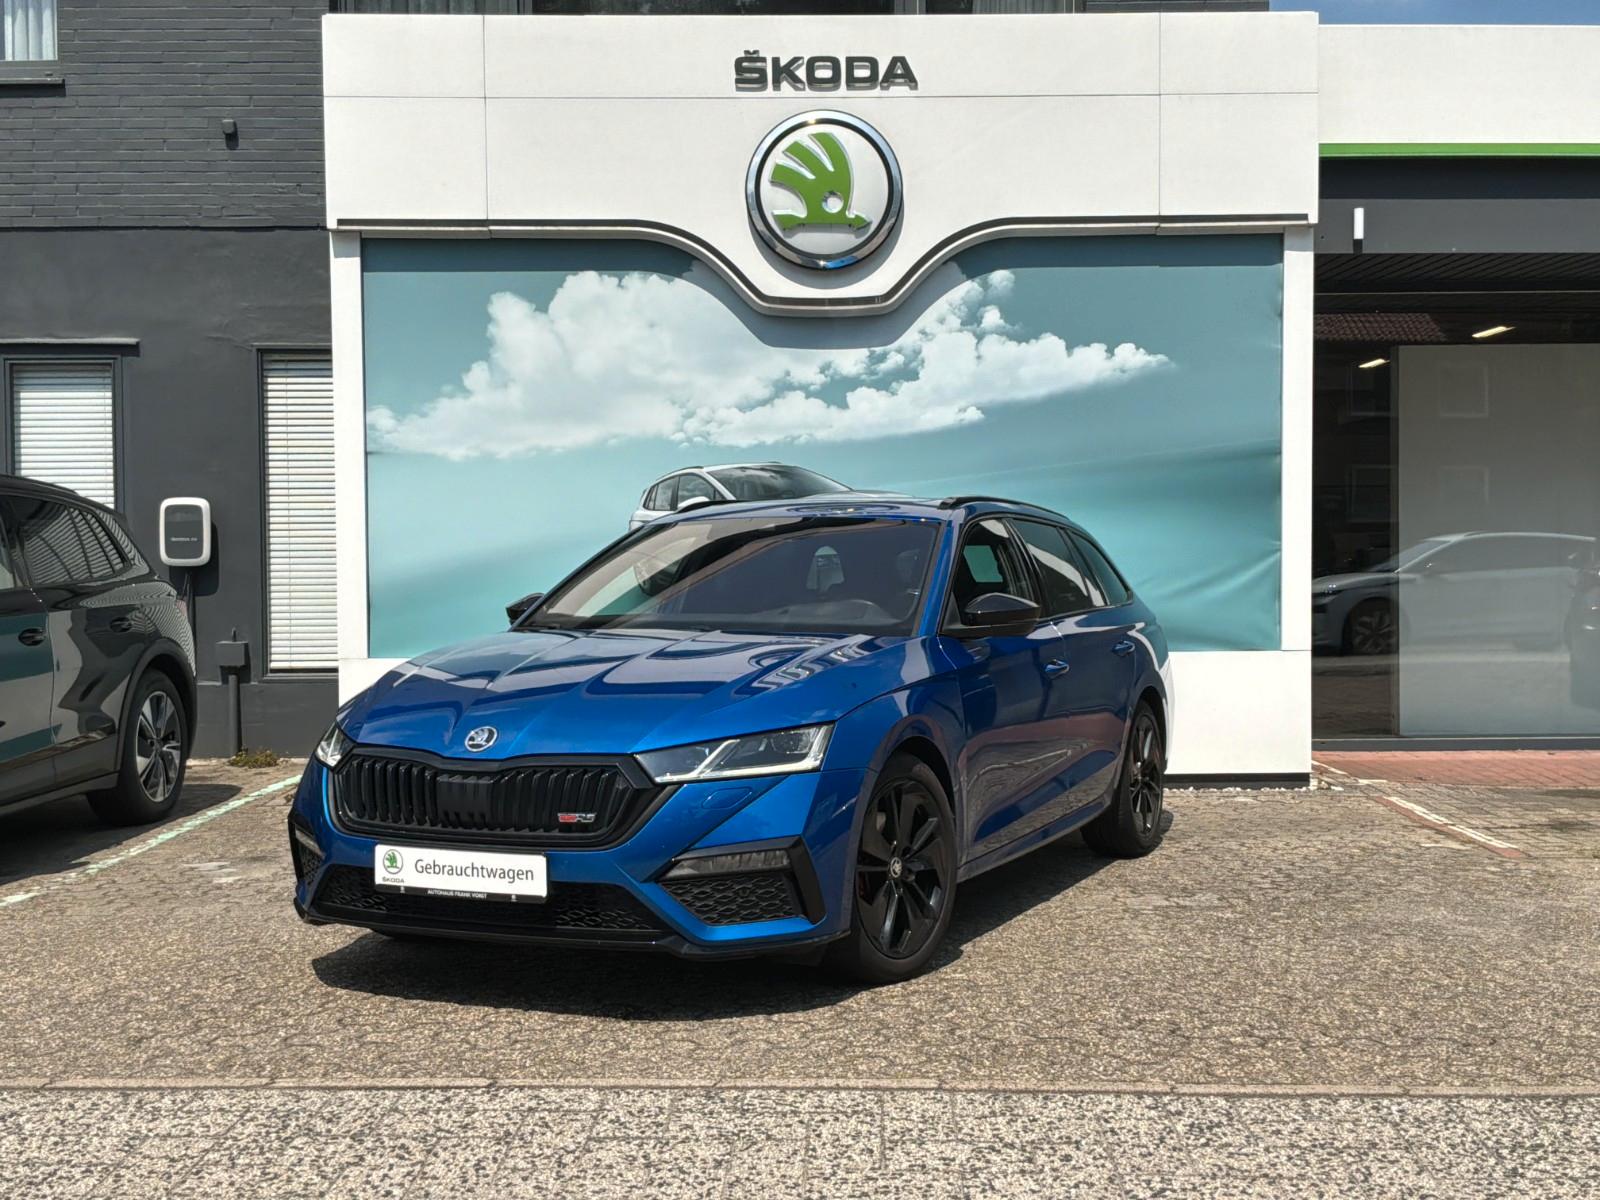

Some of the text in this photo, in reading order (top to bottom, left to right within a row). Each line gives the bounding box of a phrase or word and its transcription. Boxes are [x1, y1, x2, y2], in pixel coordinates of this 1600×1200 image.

[734, 50, 918, 92] ŠKODA
[414, 858, 534, 884] Gebrauchtwagen
[382, 876, 405, 884] ŠKODA
[427, 889, 454, 897] AUTOHAUS
